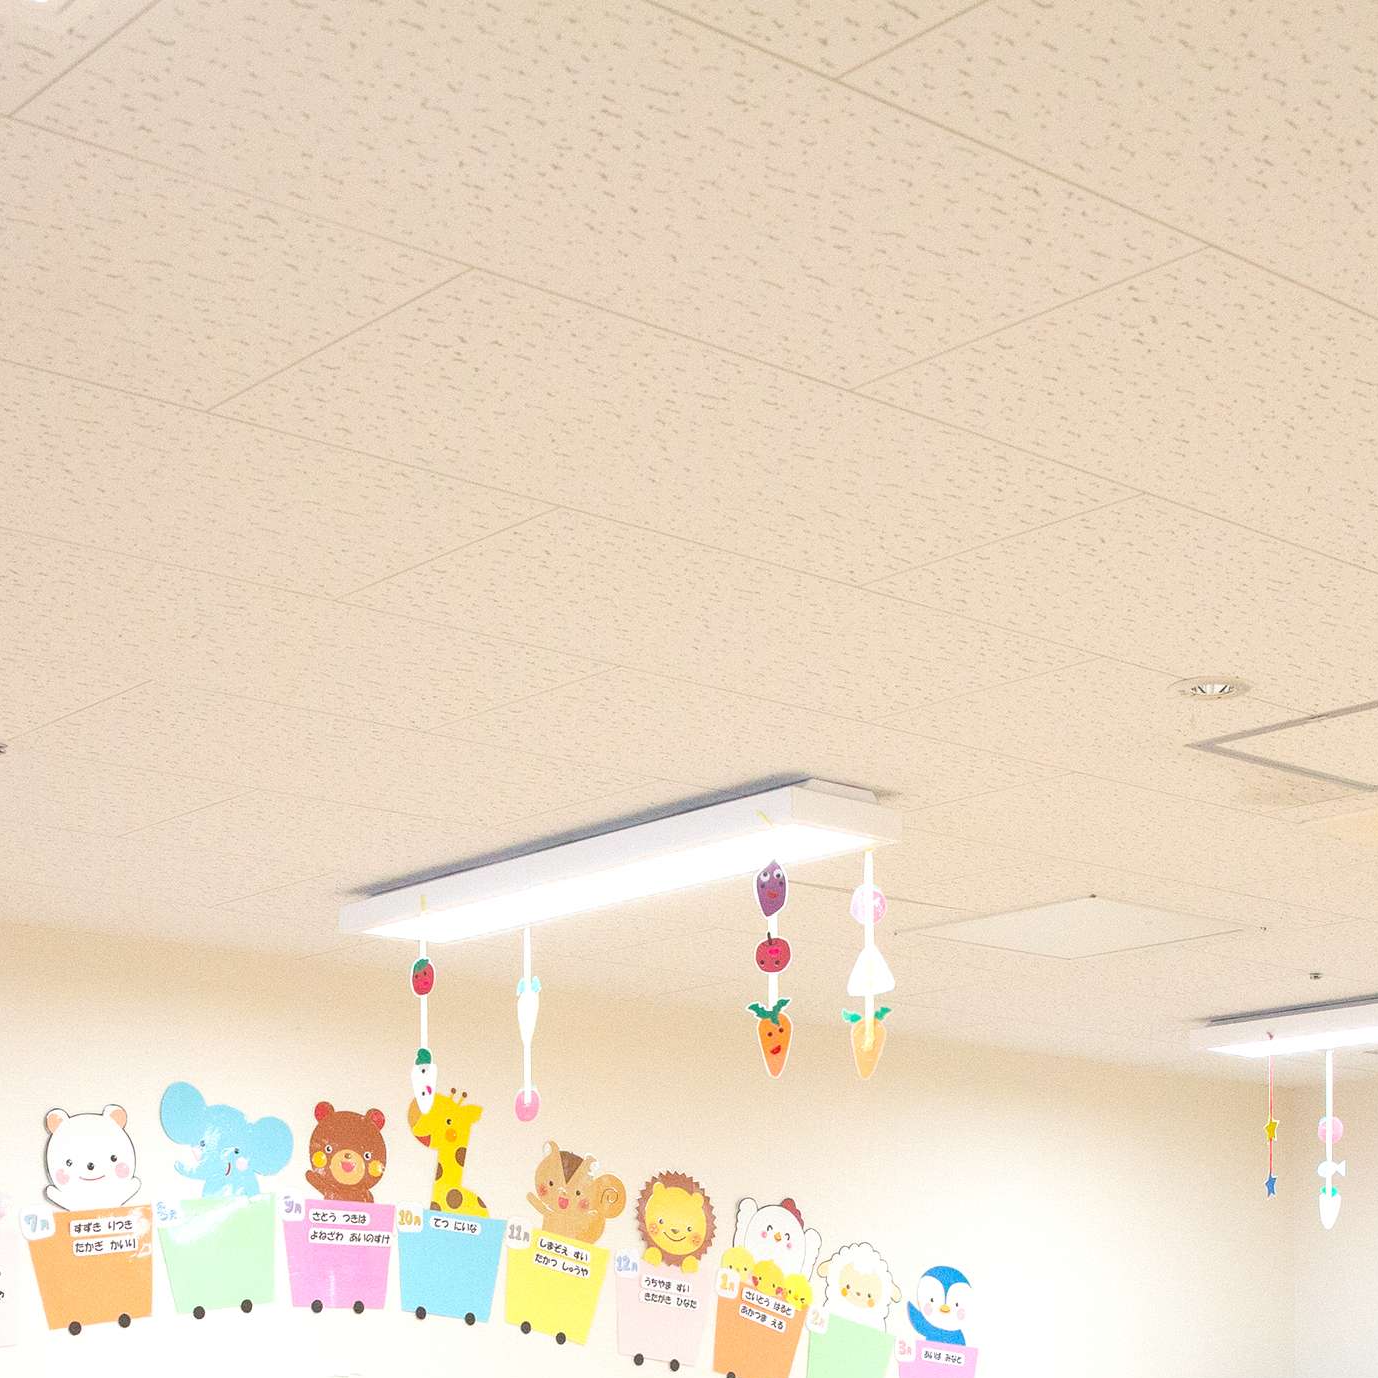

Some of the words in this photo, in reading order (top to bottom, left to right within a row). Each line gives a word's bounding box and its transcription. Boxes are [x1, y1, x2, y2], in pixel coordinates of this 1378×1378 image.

[312, 1212, 337, 1222] さとう
[74, 1222, 102, 1234] すずき
[108, 1220, 133, 1231] りつき
[310, 1229, 344, 1241] よねざわ
[349, 1232, 391, 1244] あいのすけ
[745, 1291, 770, 1307] さいとう
